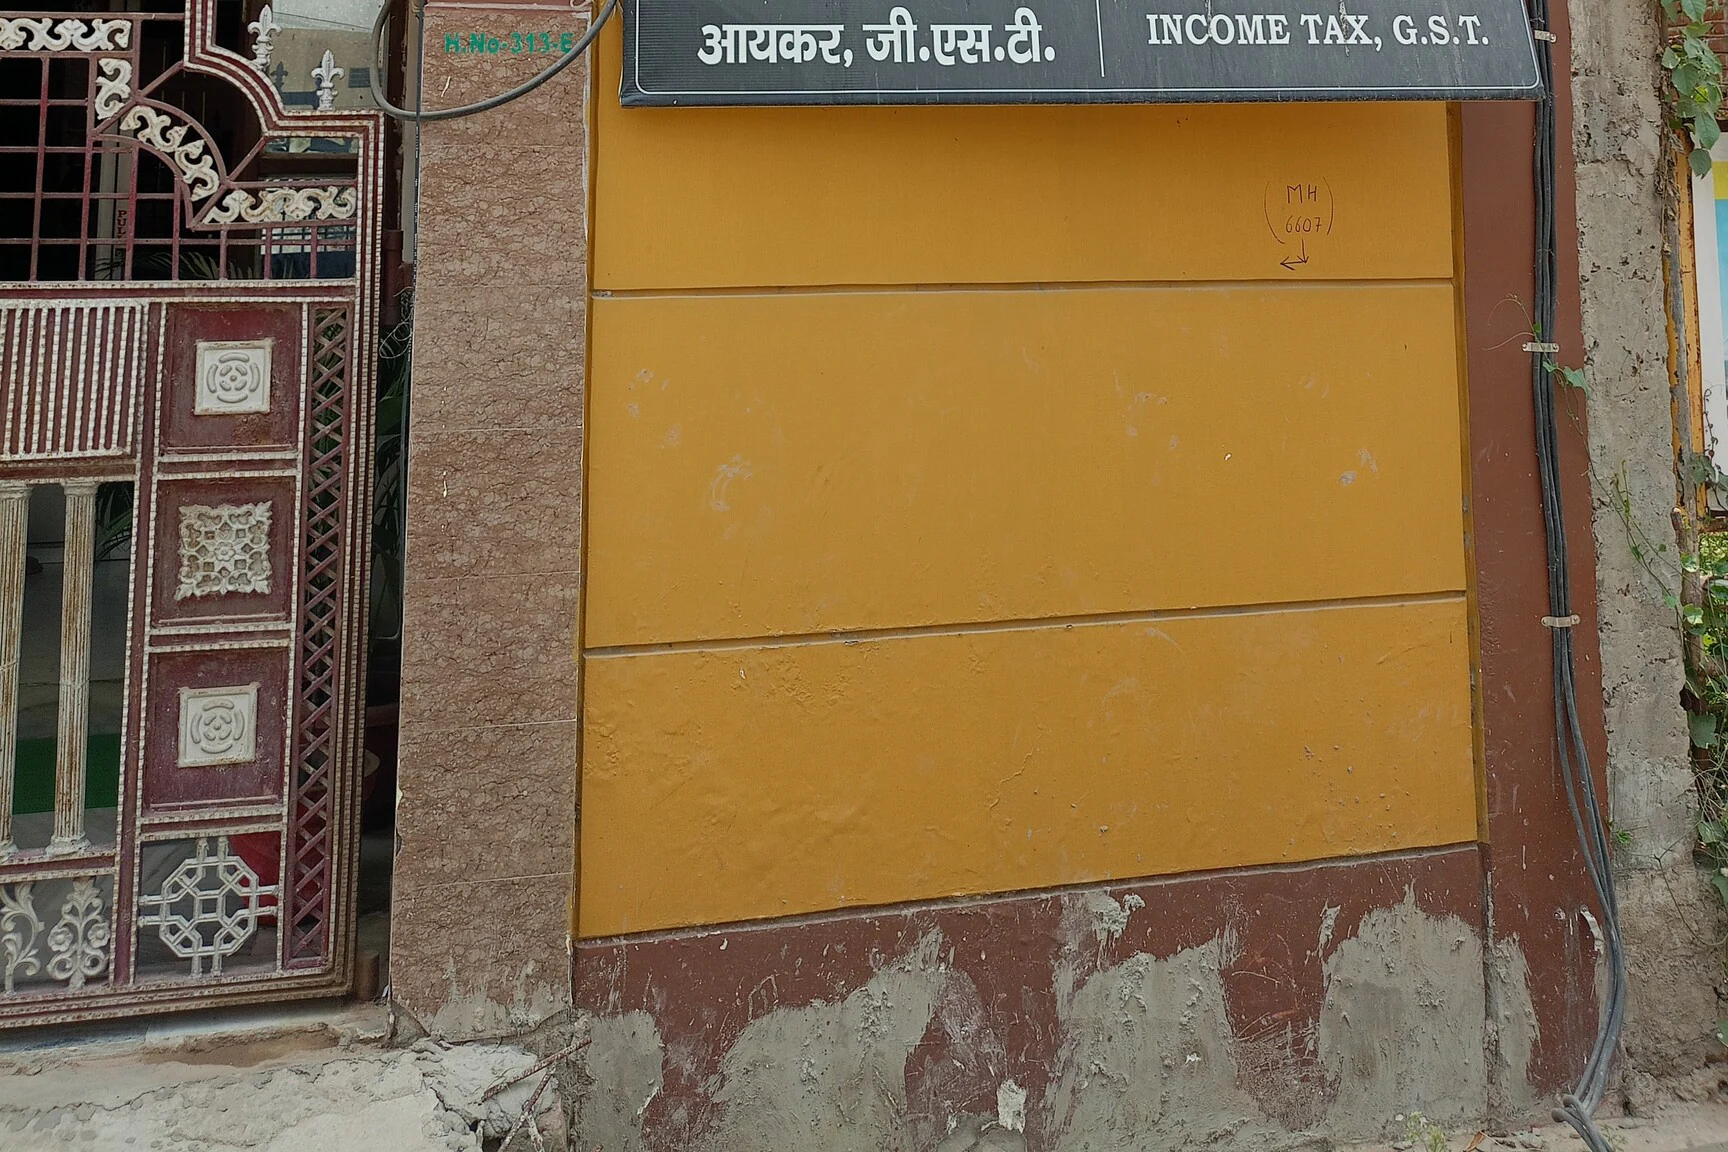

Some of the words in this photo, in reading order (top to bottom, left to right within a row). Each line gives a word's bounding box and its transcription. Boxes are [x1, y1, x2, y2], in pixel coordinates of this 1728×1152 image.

[697, 24, 854, 68] आयकर,
[862, 6, 1056, 66] जी.एस.टी.
[1145, 14, 1291, 45] INCOME
[1299, 15, 1383, 51] TAX,
[1392, 14, 1489, 45] G.S.T.
